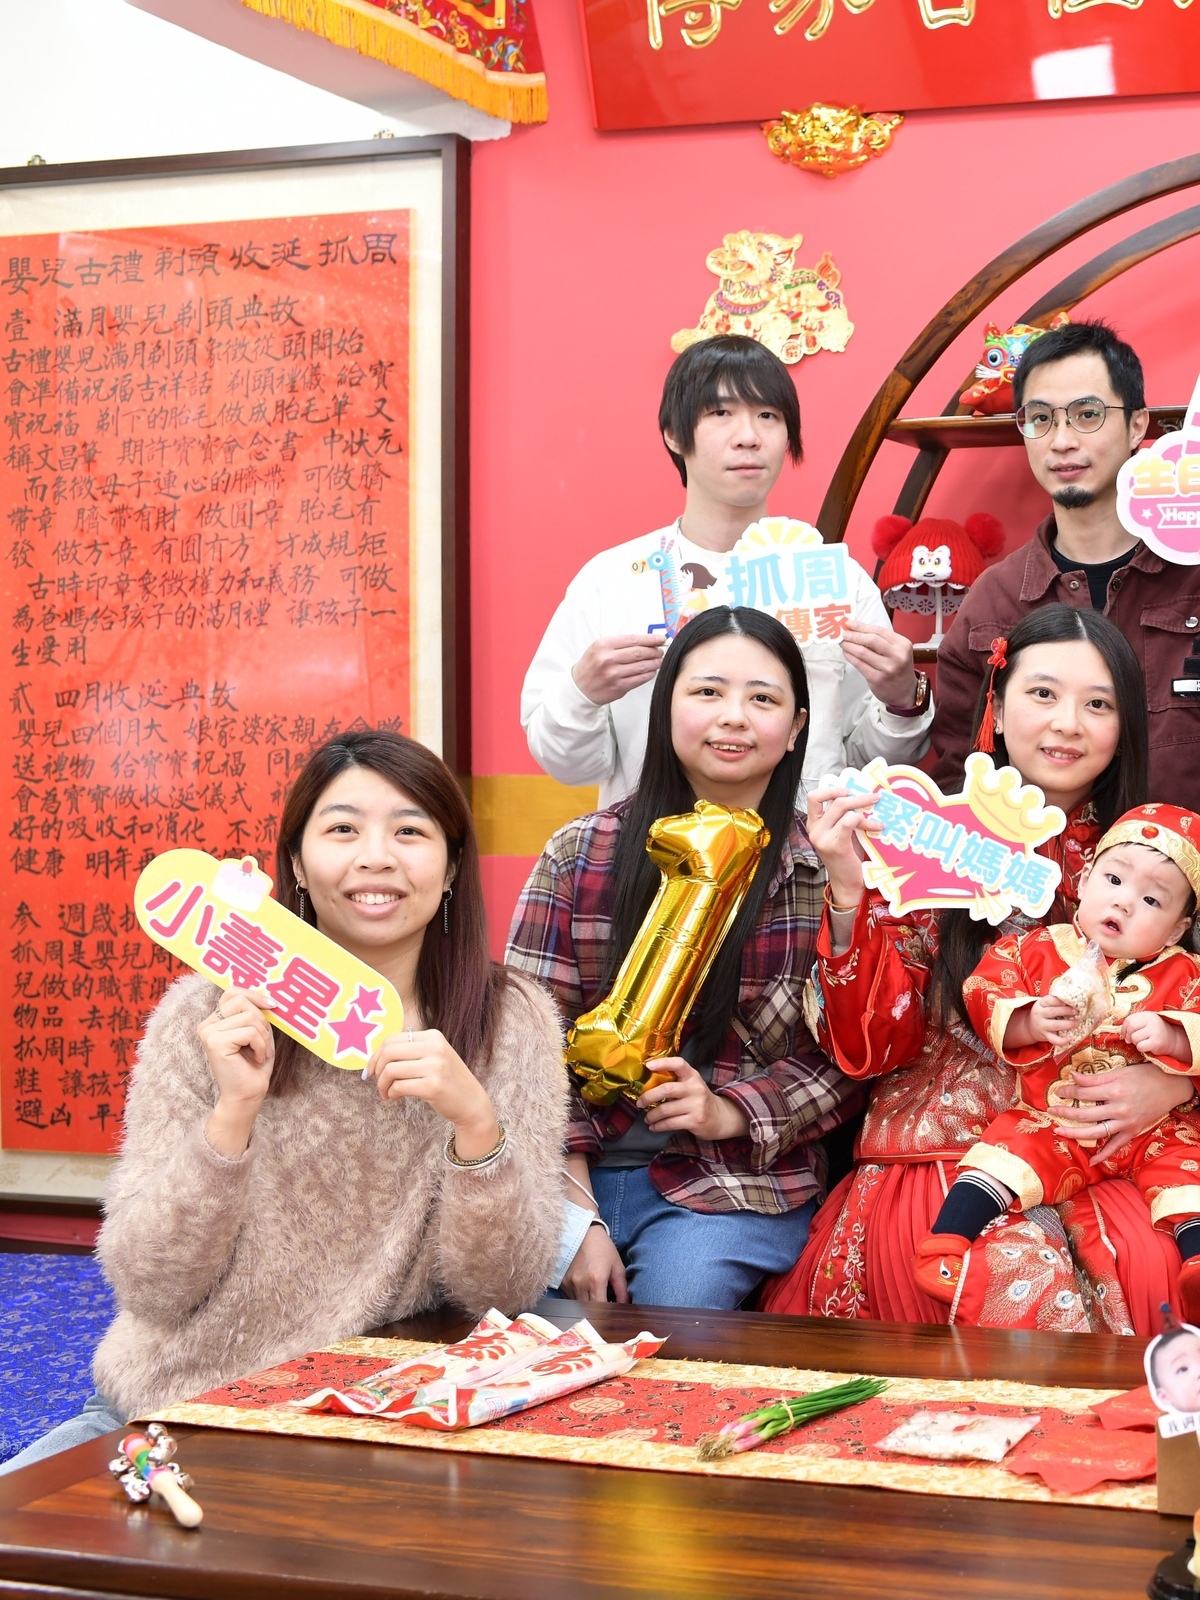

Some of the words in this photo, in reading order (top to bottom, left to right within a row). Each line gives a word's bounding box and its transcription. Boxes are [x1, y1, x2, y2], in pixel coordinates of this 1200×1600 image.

[5, 308, 31, 343] 壹
[366, 397, 395, 422] 又
[5, 539, 35, 569] 發
[725, 547, 848, 607] 抓周
[775, 604, 852, 642] 傳家
[9, 681, 35, 715] 貳
[12, 717, 168, 748] 嬰兒四個月大
[9, 811, 206, 844] 好的吸收和消化
[9, 846, 66, 879] 健康
[11, 939, 193, 973] 抓周是嬰兒周
[145, 881, 340, 1040] 小壽星
[13, 1003, 64, 1030] 物品
[13, 1034, 95, 1067] 抓周時
[14, 1068, 42, 1096] 鞋
[15, 1098, 71, 1129] 避凶
